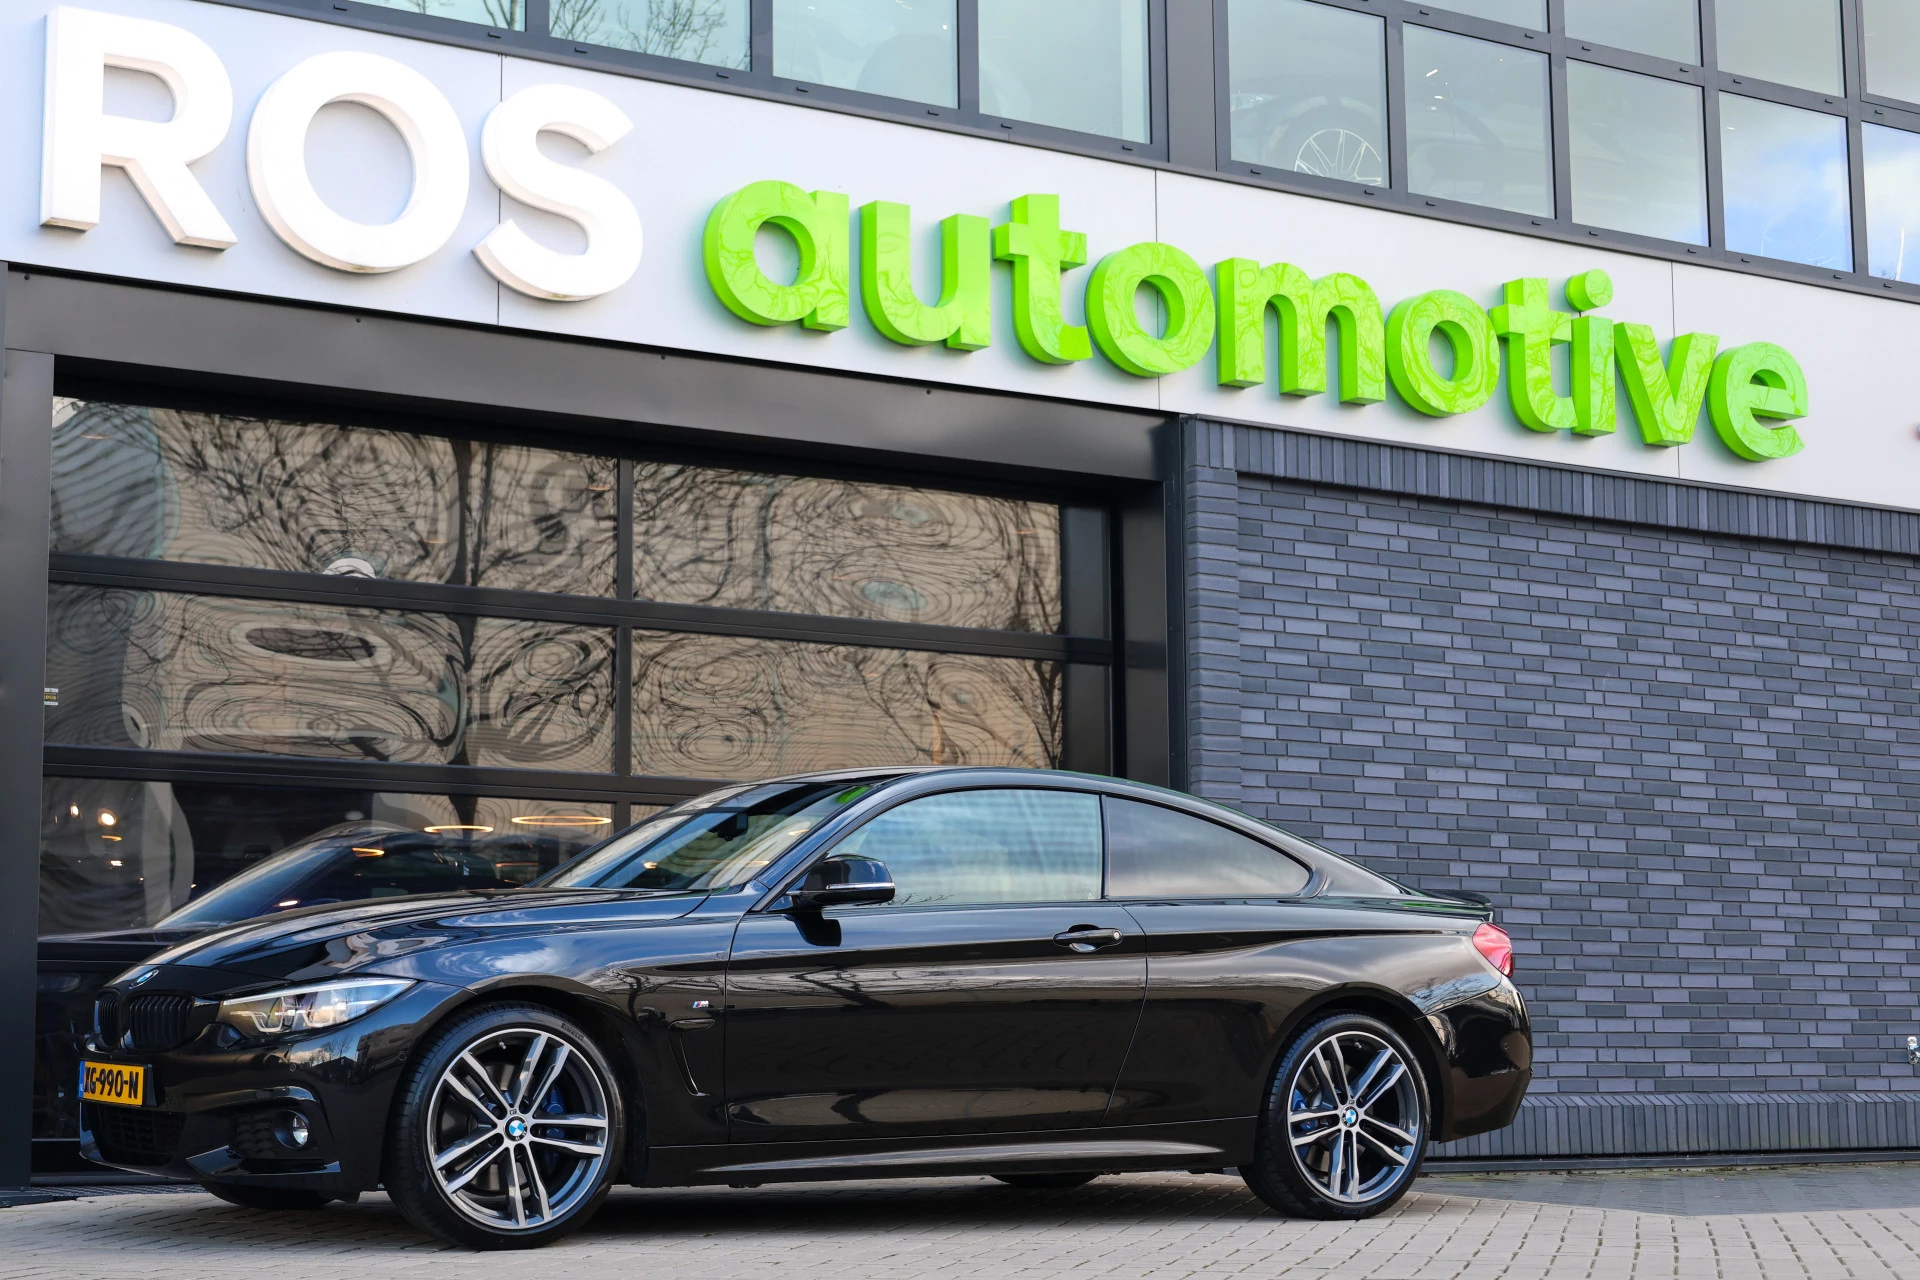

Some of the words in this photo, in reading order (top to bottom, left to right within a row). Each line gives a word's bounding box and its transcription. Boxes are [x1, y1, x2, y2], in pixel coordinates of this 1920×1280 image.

[40, 4, 642, 302] ROS
[703, 180, 1808, 462] automotive
[84, 1066, 139, 1099] XG-990-N
